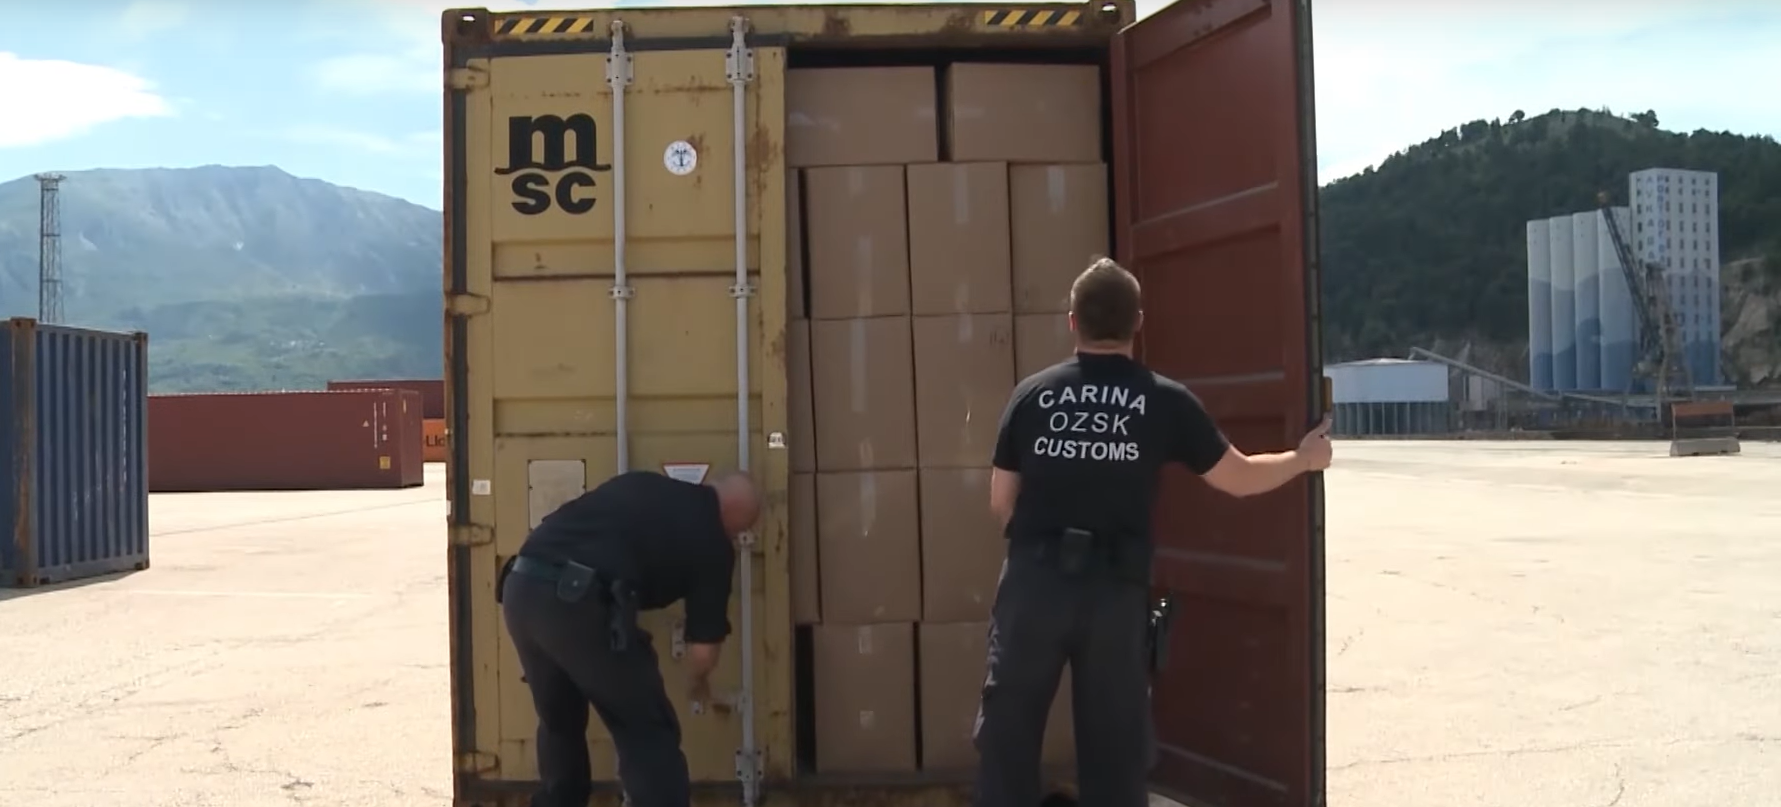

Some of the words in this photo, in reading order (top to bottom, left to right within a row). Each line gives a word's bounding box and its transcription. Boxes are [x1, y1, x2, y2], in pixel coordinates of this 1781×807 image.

[1039, 384, 1145, 415] CARINA
[1049, 411, 1130, 436] OZSK
[1034, 437, 1139, 461] CUSTOMS
